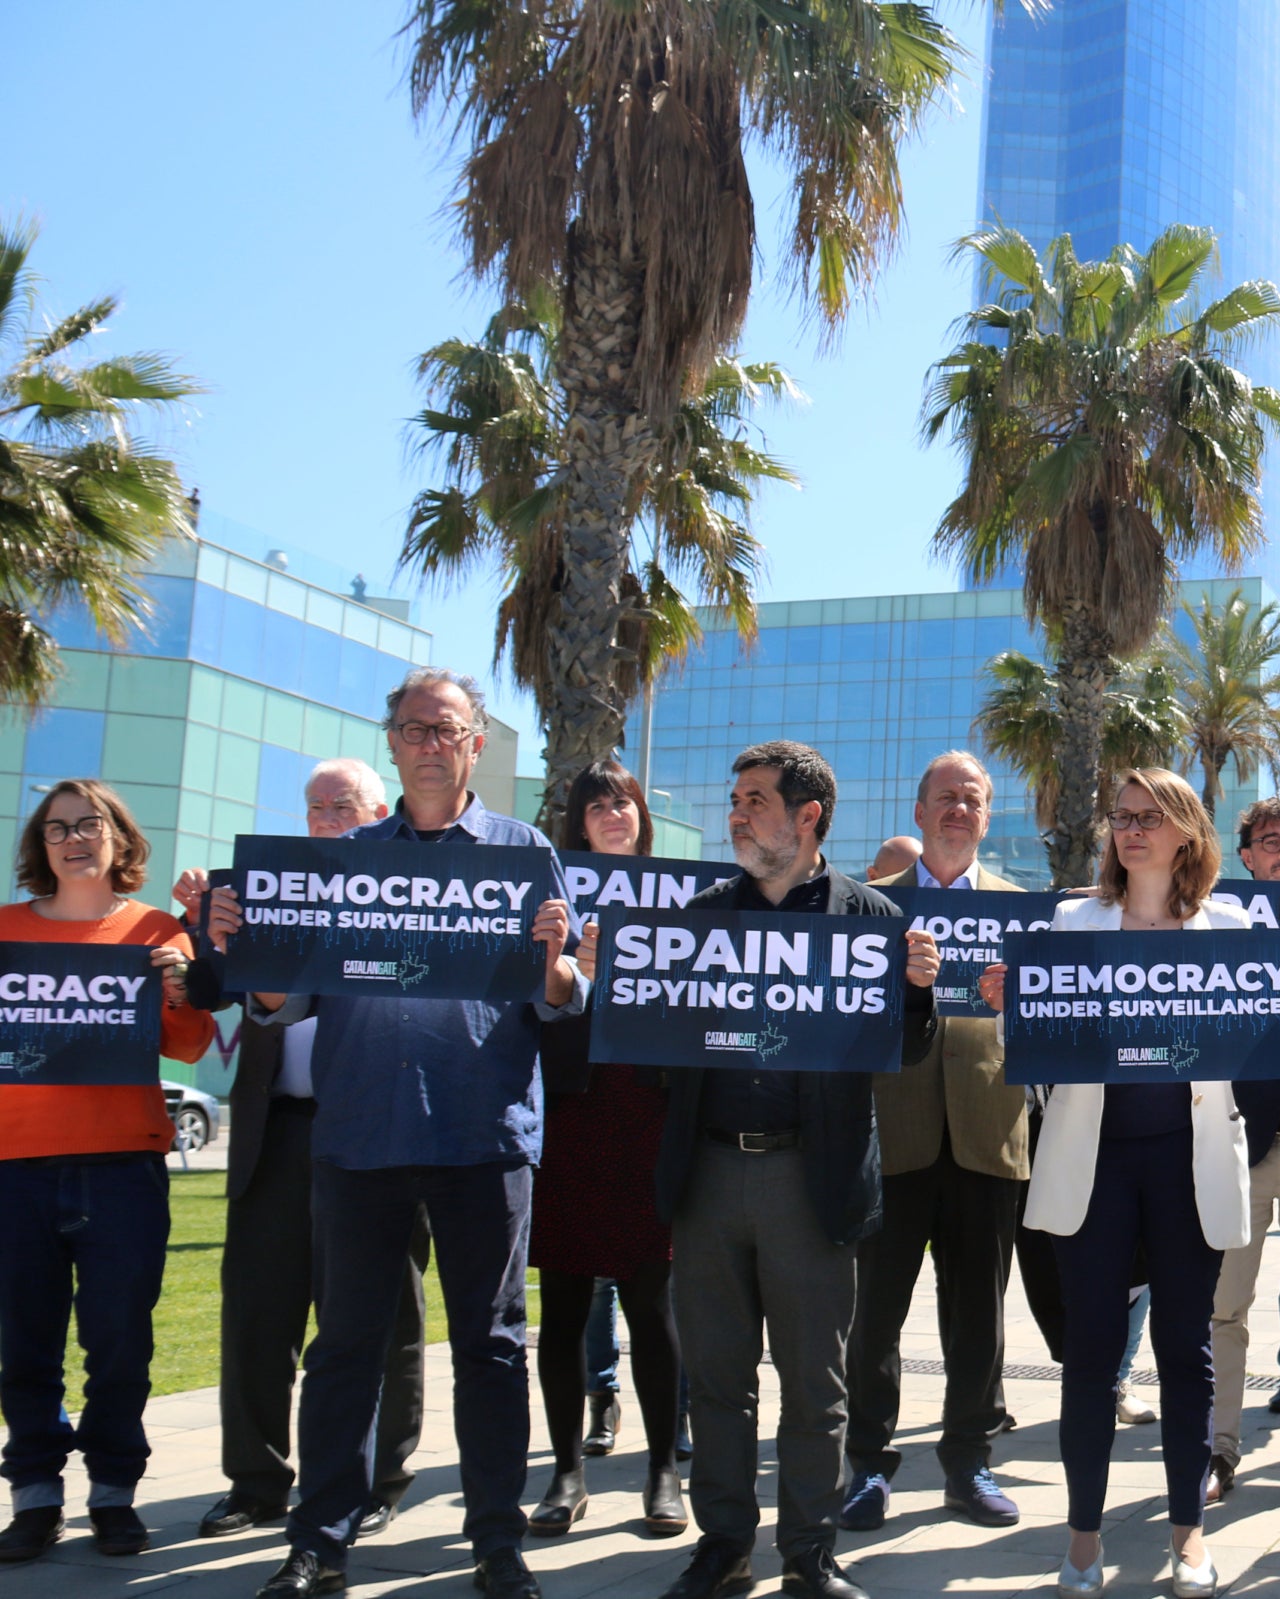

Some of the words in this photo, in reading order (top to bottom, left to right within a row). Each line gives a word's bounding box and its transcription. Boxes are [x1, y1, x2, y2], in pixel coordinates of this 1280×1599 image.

[245, 870, 533, 911] DEMOCRACY
[244, 907, 331, 927] UNDER
[338, 911, 521, 935] SURVEILLANCE
[613, 924, 809, 976] SPAIN
[830, 933, 889, 979] IS
[344, 960, 397, 975] CATALANGATE
[611, 977, 755, 1011] SPYING
[765, 983, 822, 1013] ON
[835, 986, 886, 1014] US
[1020, 1000, 1101, 1018] UNDER
[705, 1031, 757, 1047] CATALANGATE
[1117, 1047, 1169, 1061] CATALANGATE
